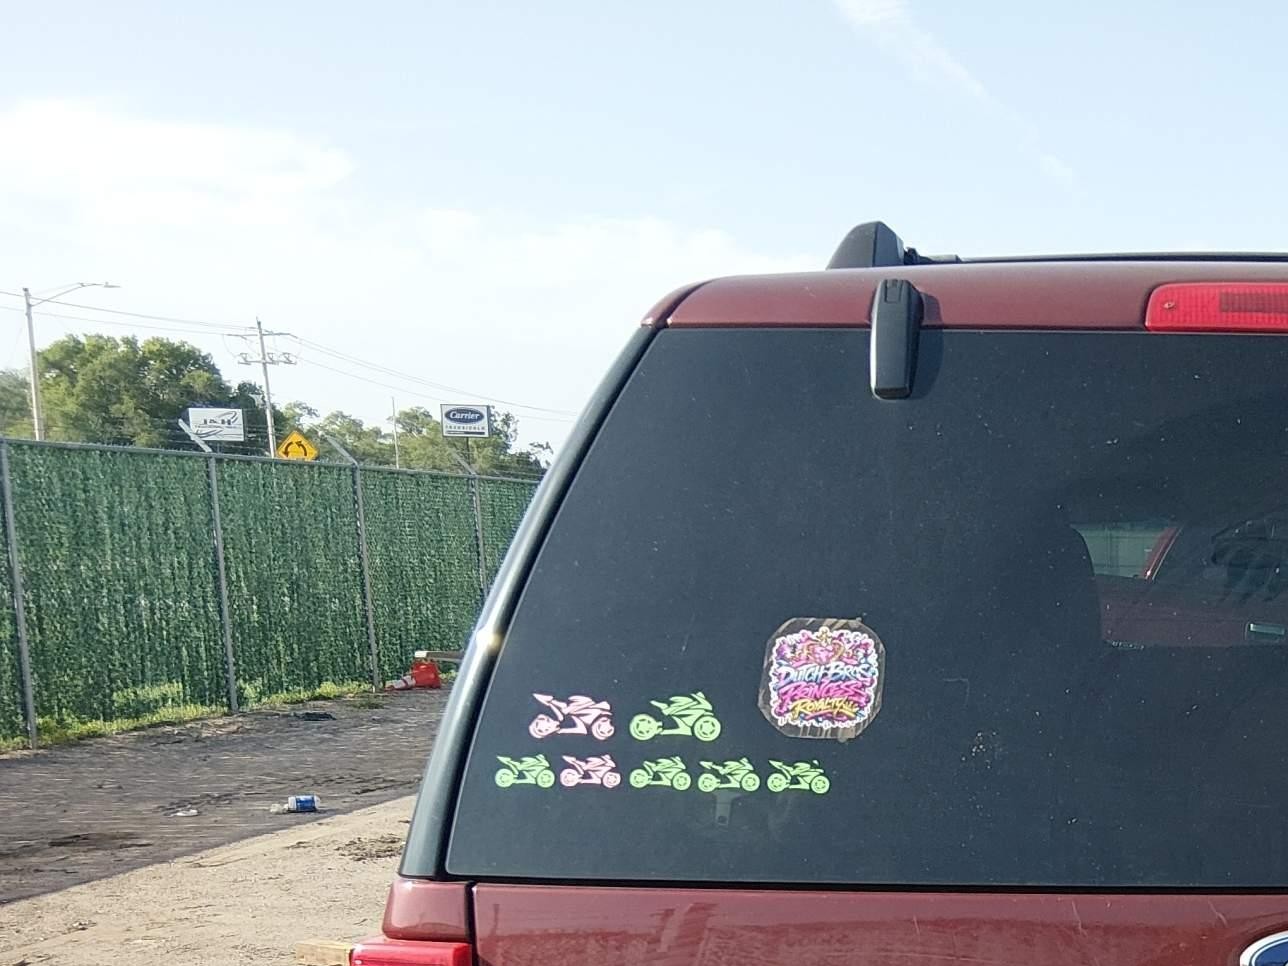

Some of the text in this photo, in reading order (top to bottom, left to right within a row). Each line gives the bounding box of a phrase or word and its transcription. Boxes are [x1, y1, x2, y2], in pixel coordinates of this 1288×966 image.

[449, 410, 481, 420] Carrier
[776, 662, 873, 685] DUTCH BROS
